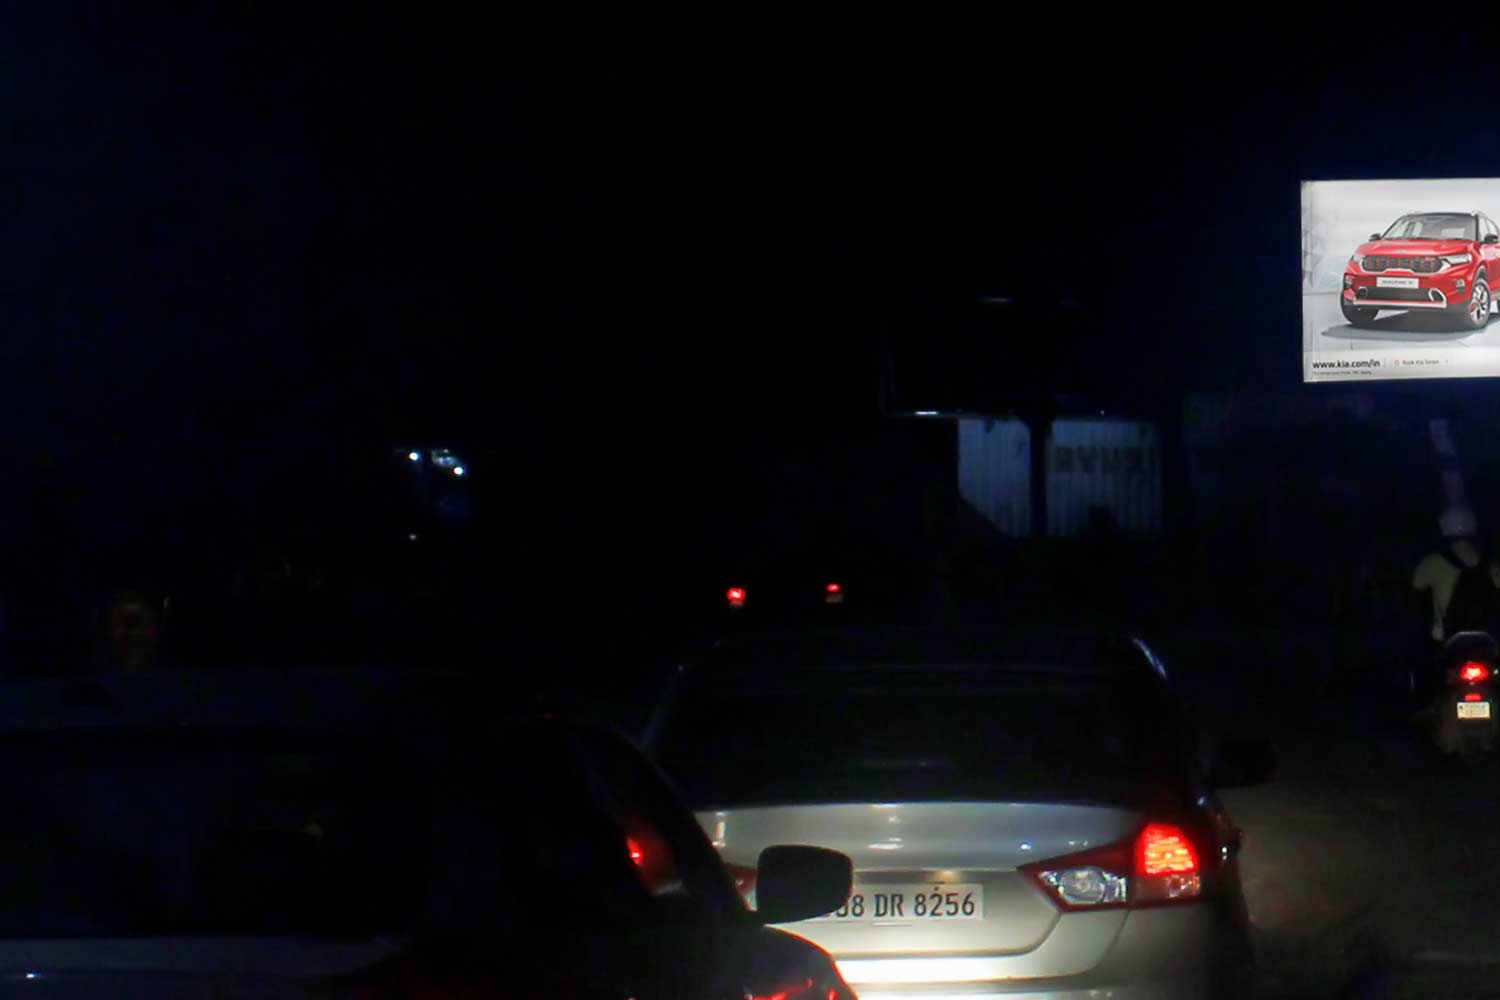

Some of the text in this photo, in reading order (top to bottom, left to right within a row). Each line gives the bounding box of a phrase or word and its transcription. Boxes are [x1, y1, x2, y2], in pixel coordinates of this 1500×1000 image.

[1312, 358, 1381, 369] www.kia.com/in
[874, 893, 904, 917] DR
[914, 892, 975, 917] 8256
